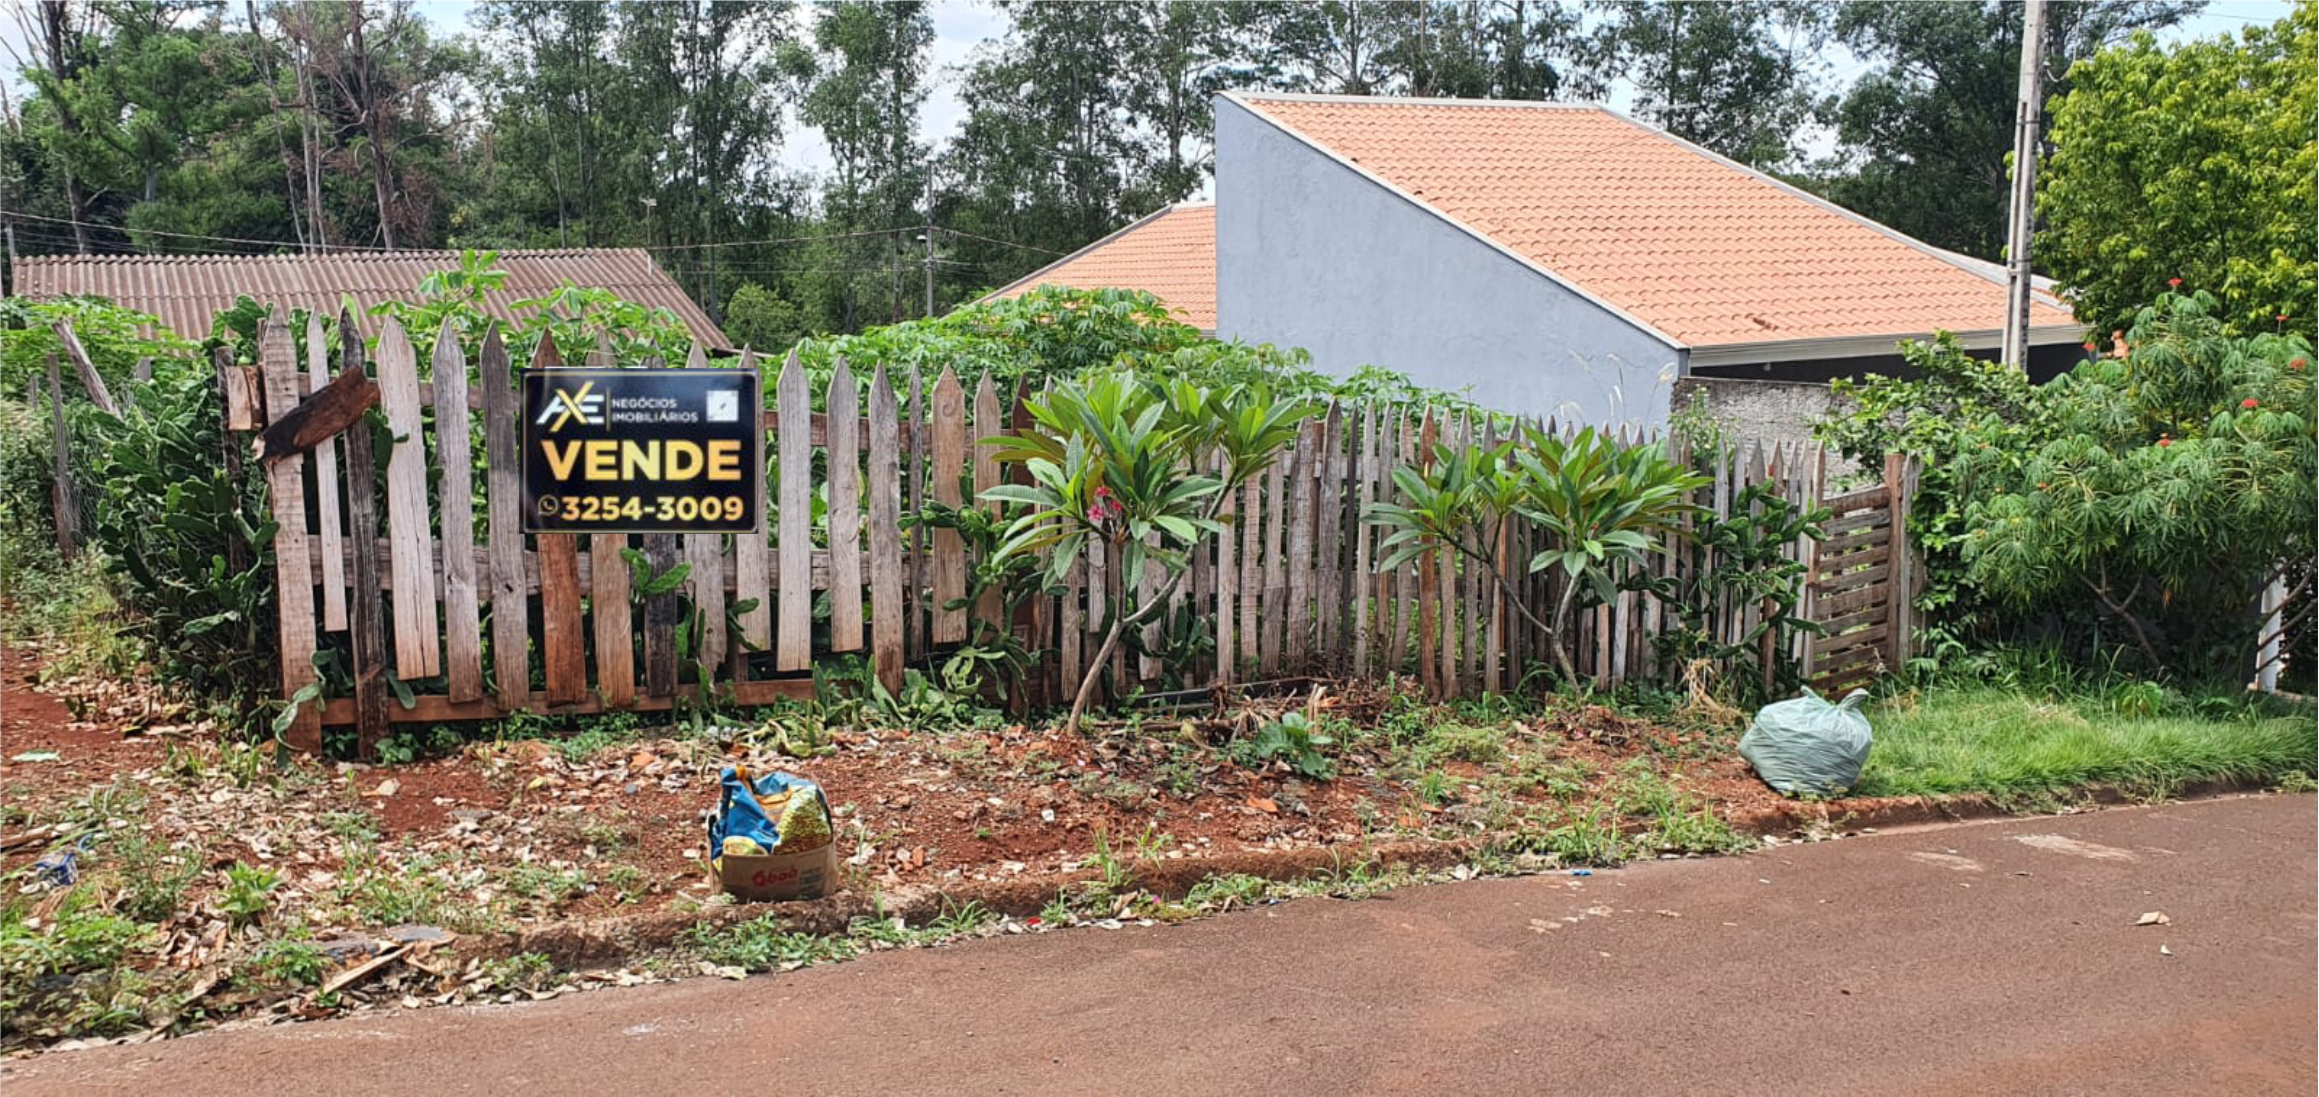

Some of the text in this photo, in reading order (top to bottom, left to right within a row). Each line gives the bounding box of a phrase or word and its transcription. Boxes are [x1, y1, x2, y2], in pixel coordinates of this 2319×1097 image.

[536, 380, 604, 432] AXE
[611, 396, 677, 409] NEGÓCIOS
[611, 411, 698, 422] IMOBILIÁRIOS
[540, 440, 742, 481] VENDE
[561, 496, 744, 521] 3254-3009
